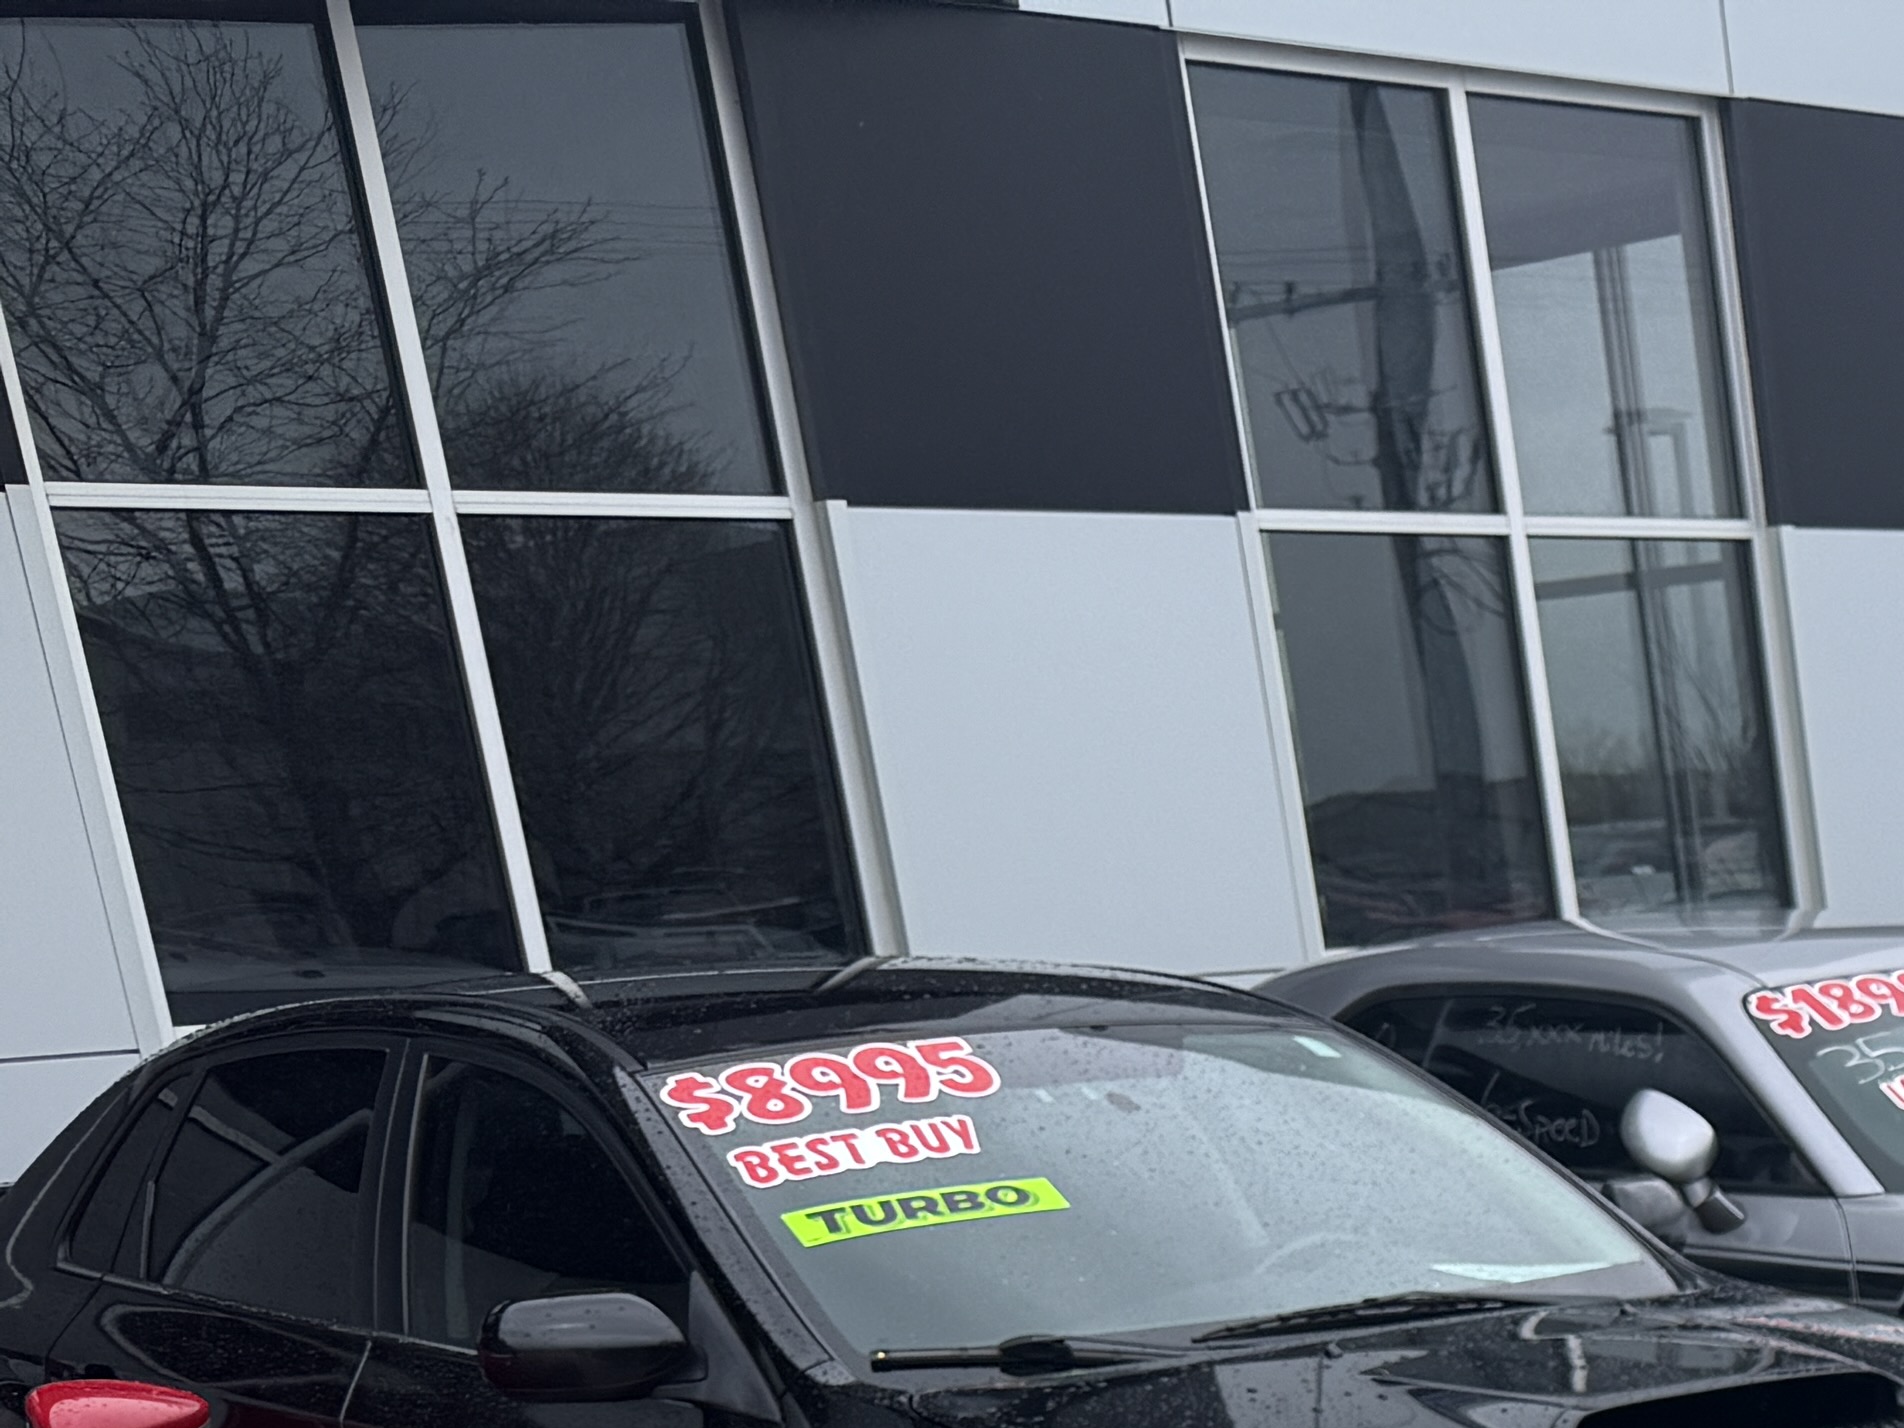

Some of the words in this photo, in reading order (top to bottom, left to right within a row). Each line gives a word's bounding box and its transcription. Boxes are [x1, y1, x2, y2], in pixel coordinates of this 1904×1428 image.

[660, 1036, 1001, 1135] $8995
[731, 1132, 867, 1186] BEST
[874, 1117, 979, 1161] BUY
[805, 1184, 1033, 1235] TURBO
